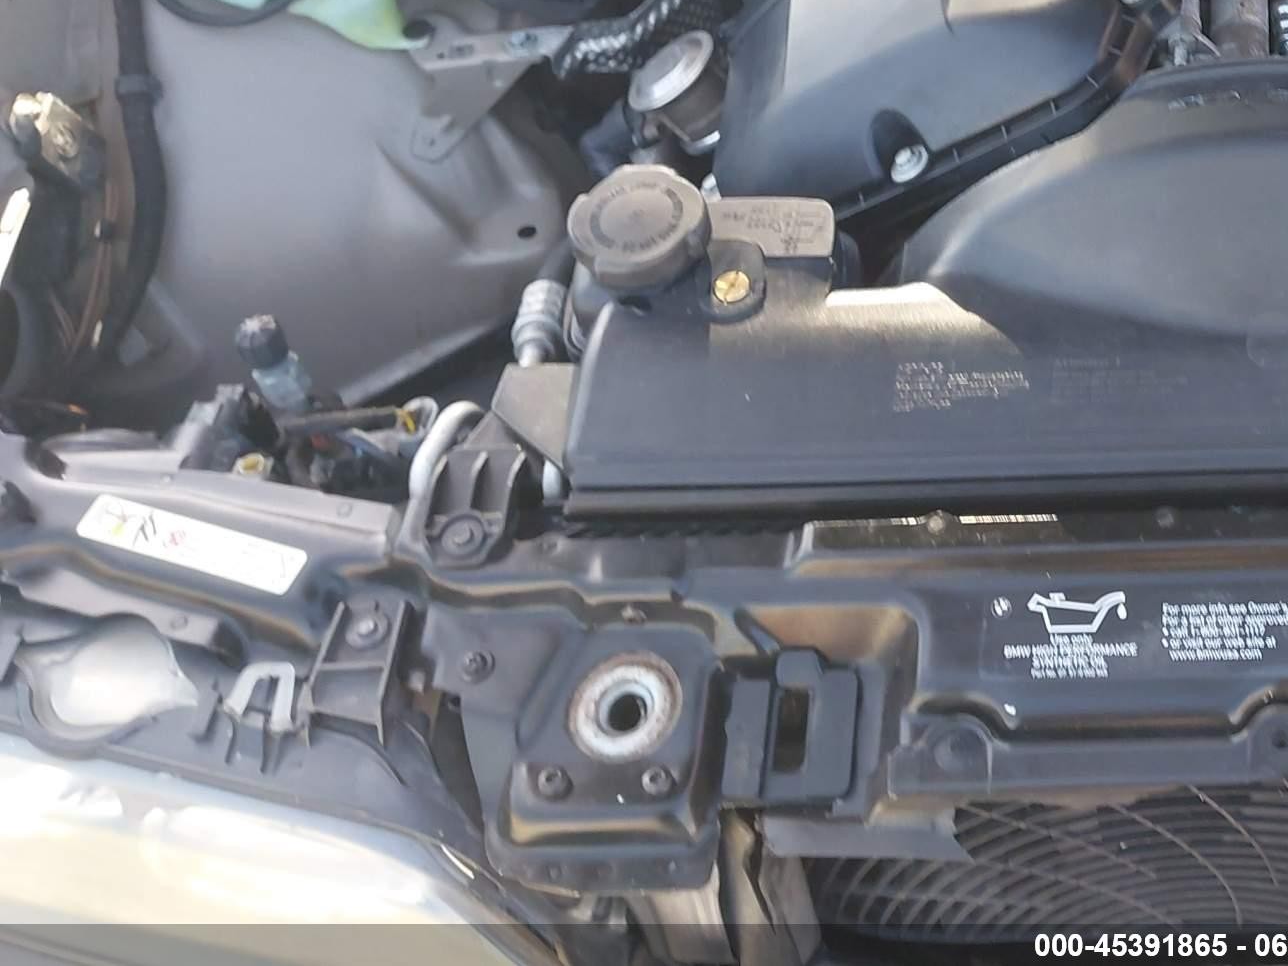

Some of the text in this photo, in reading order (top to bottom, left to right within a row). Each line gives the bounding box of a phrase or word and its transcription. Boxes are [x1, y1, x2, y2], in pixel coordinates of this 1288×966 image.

[1162, 602, 1180, 615] For
[1181, 603, 1207, 615] more
[1003, 644, 1031, 658] BMW
